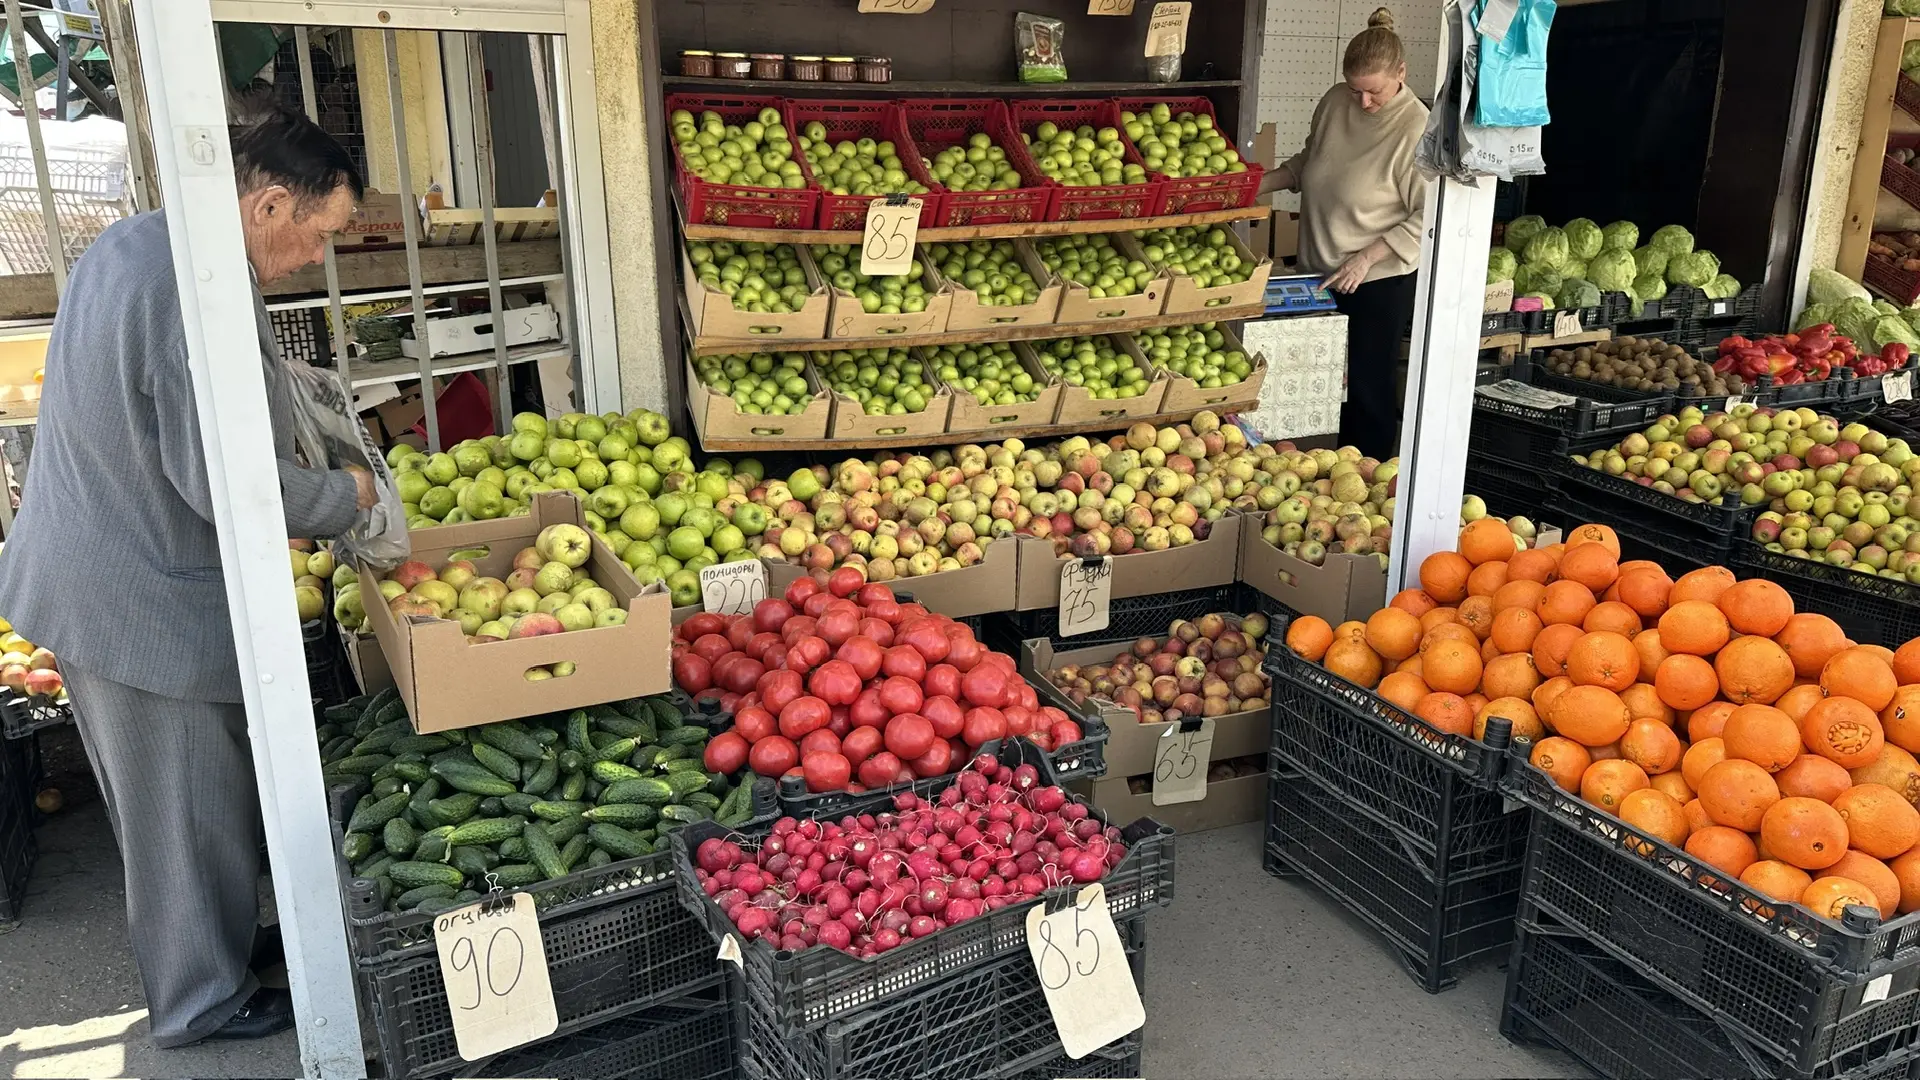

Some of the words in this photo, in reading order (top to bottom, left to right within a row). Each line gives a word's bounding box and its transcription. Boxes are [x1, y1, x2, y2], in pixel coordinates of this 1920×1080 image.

[1488, 152, 1496, 163] 15
[1516, 144, 1526, 153] 15
[867, 213, 915, 261] 85
[706, 578, 765, 617] 220
[1063, 587, 1099, 626] 75
[1156, 738, 1212, 783] 65
[1039, 889, 1101, 990] 85
[451, 926, 524, 1011] 90
